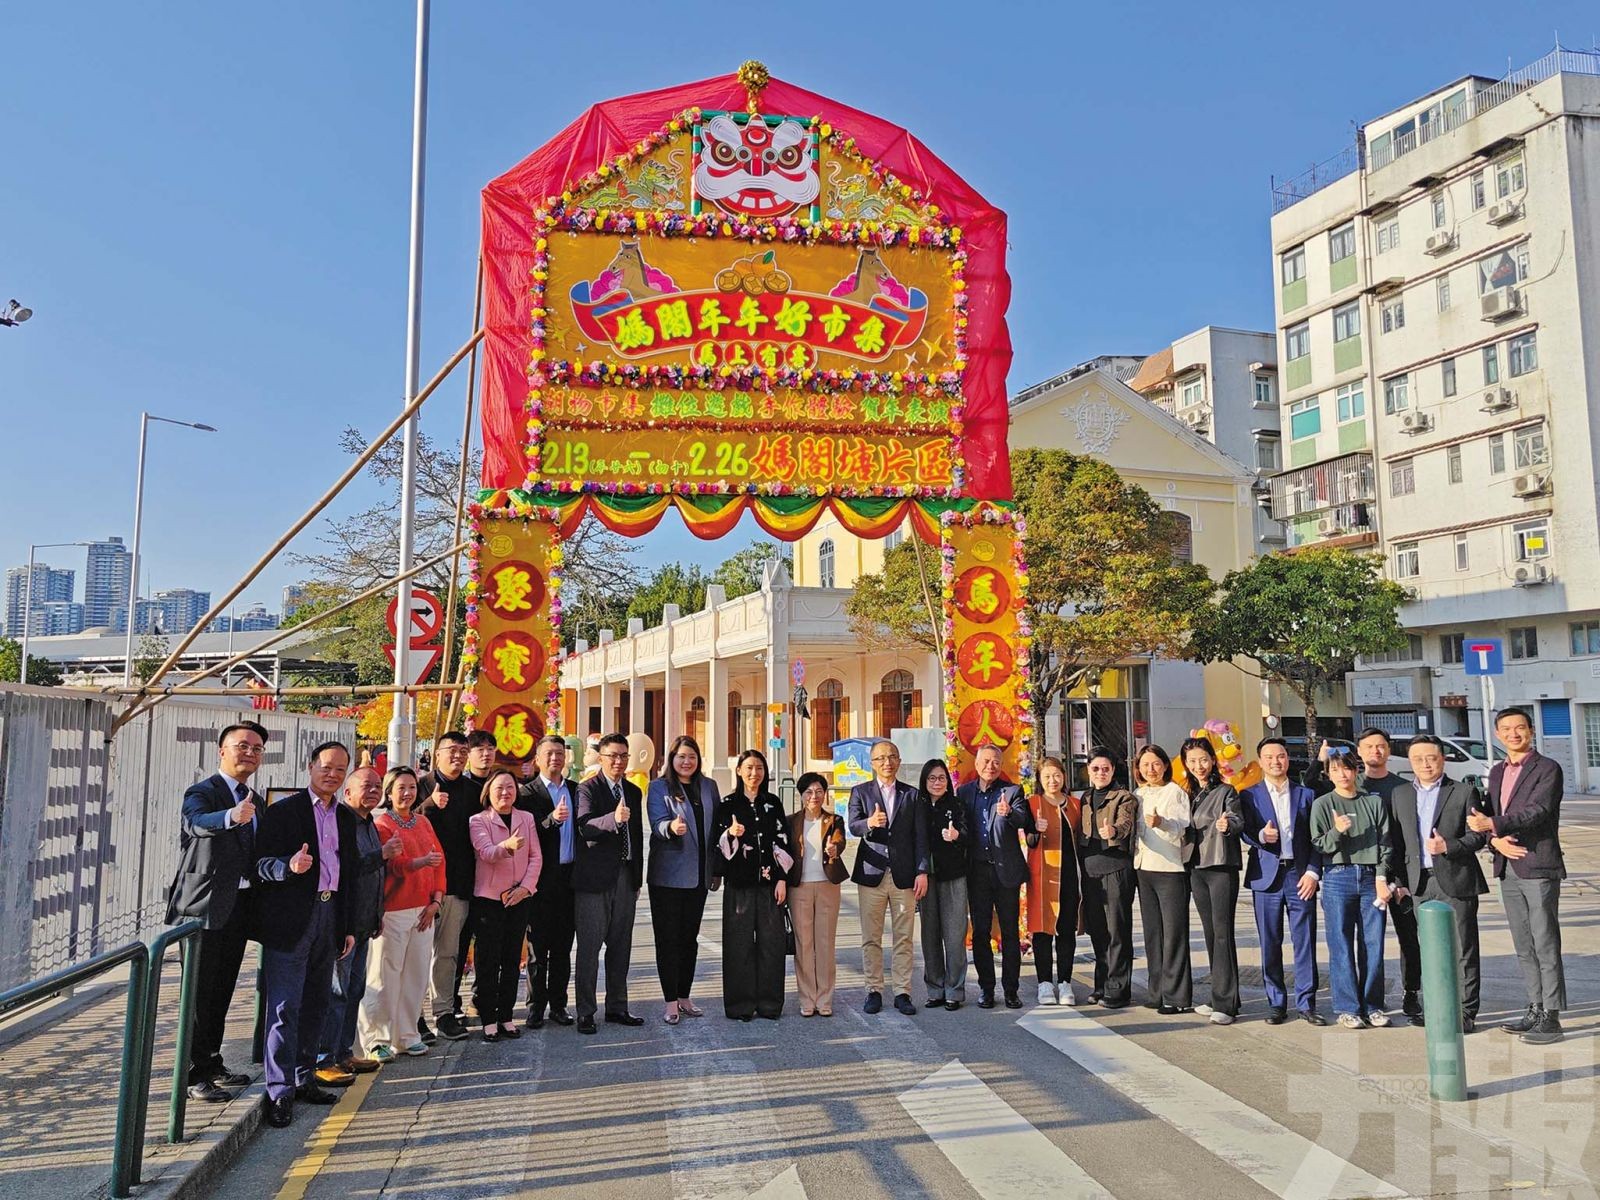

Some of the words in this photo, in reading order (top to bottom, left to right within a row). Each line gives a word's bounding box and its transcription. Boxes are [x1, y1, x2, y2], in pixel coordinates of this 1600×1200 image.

[616, 296, 885, 353] 媽閣年年好市集
[861, 395, 949, 424] 賀年表演
[689, 441, 749, 476] 2.26
[749, 435, 951, 483] 媽閣塘片區
